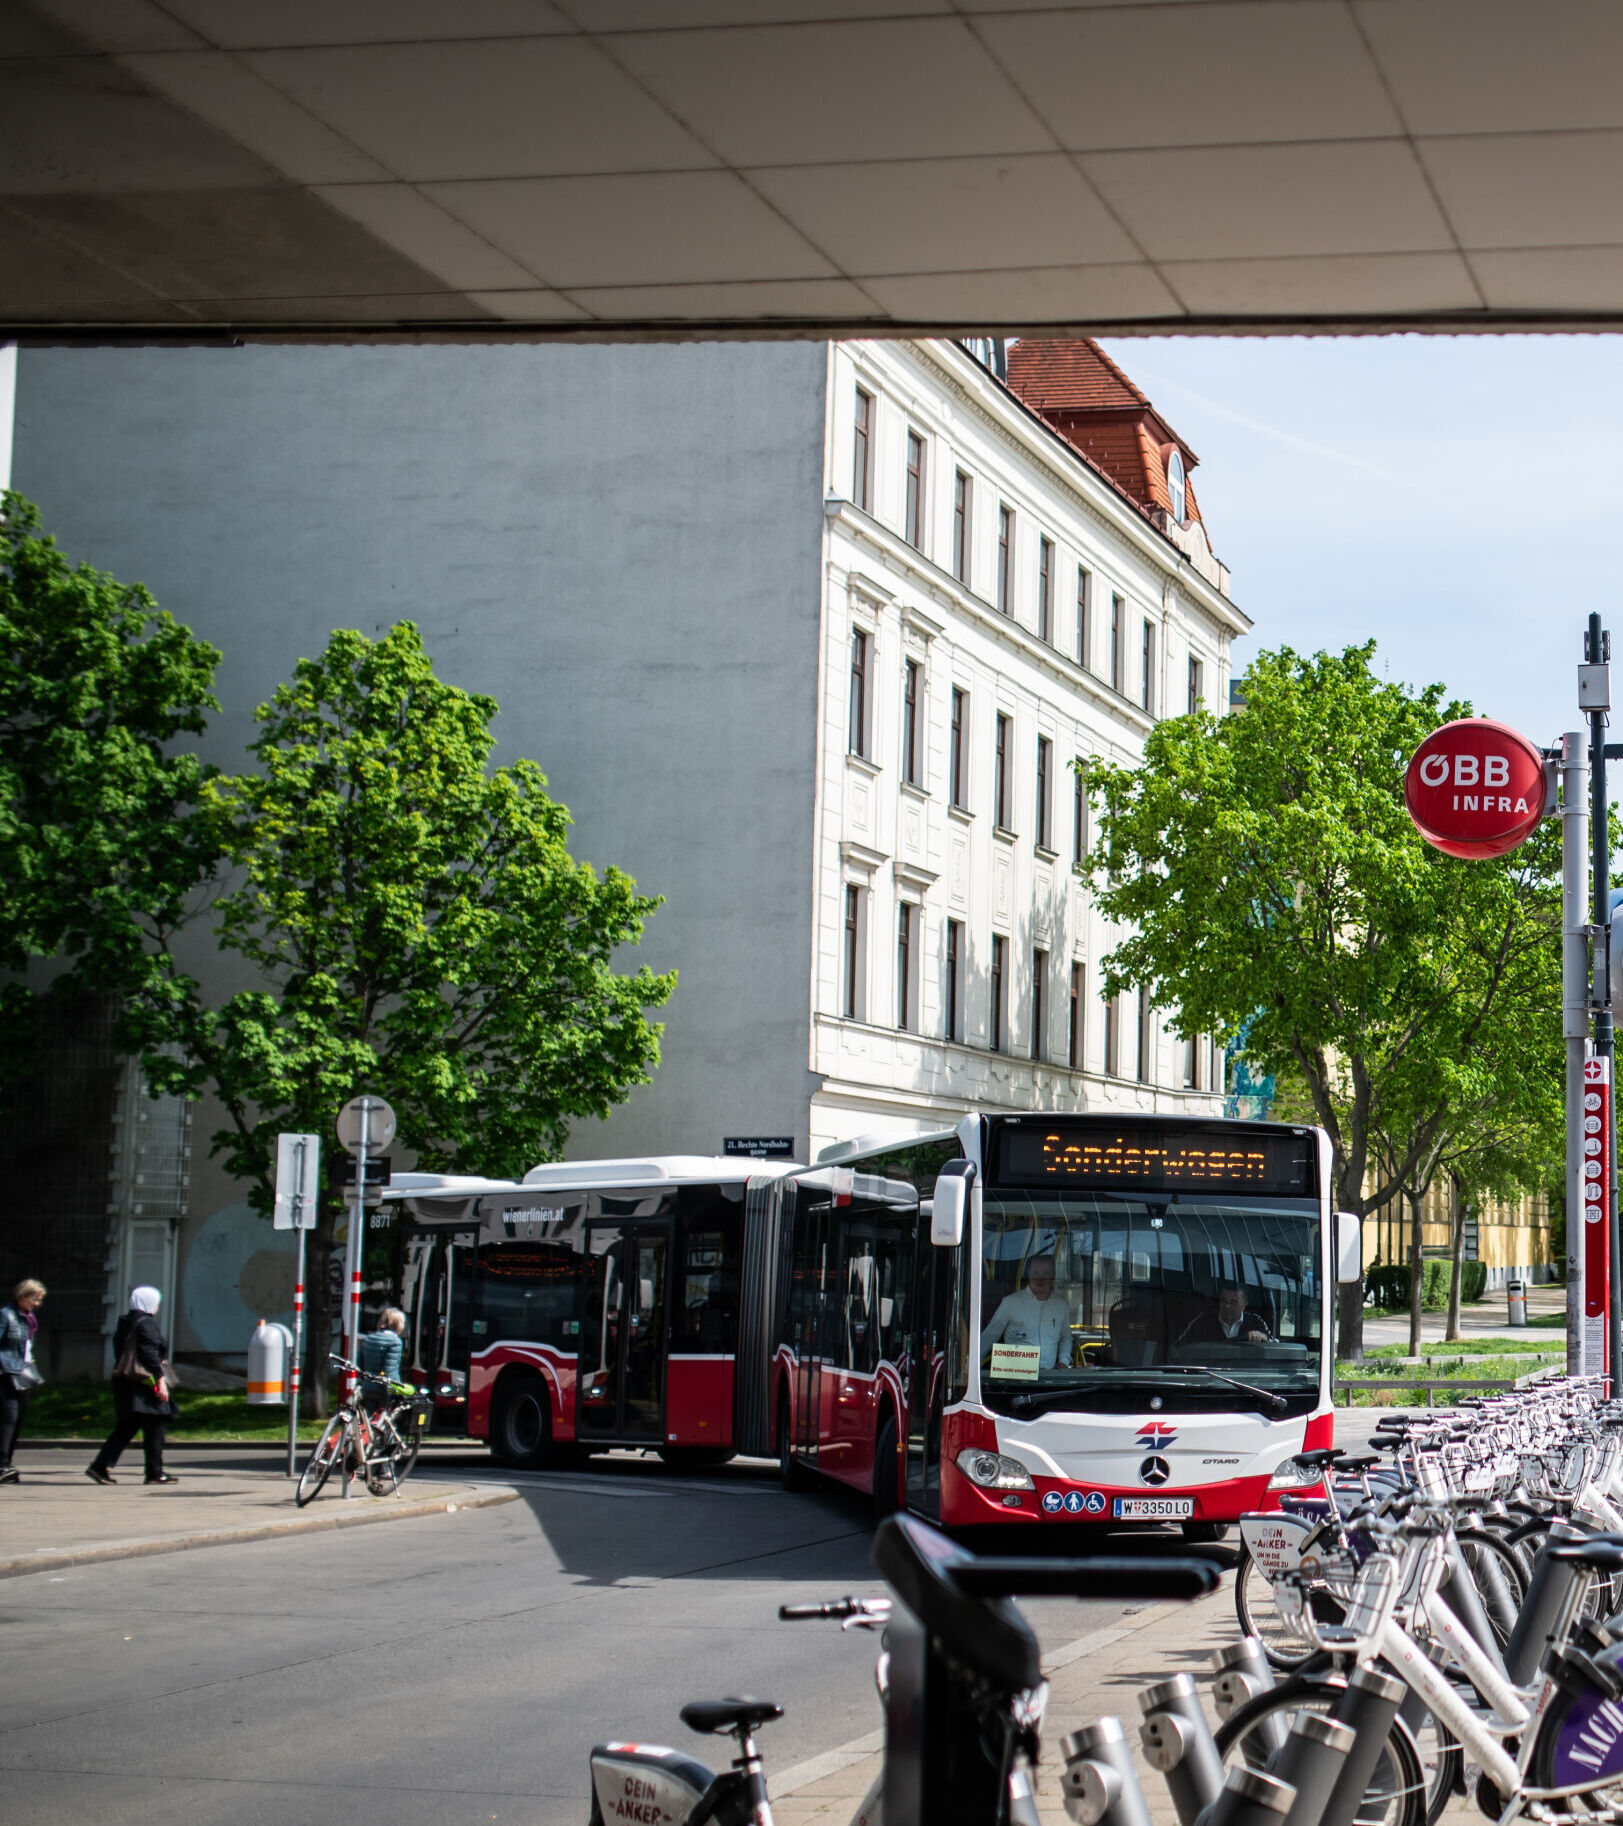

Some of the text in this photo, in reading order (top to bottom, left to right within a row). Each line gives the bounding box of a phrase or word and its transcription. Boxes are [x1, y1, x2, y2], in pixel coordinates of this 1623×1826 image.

[1420, 754, 1510, 787] ÖBB
[1453, 795, 1529, 814] INFRA
[737, 1140, 758, 1149] Rechte
[1043, 1135, 1265, 1179] Sonderwagen
[370, 1214, 390, 1229] 8871
[503, 1207, 564, 1223] wienerlinien.at
[993, 1349, 1039, 1359] SONDERFAHRT
[1262, 1527, 1283, 1538] DEIN
[624, 1777, 657, 1800] DEIN
